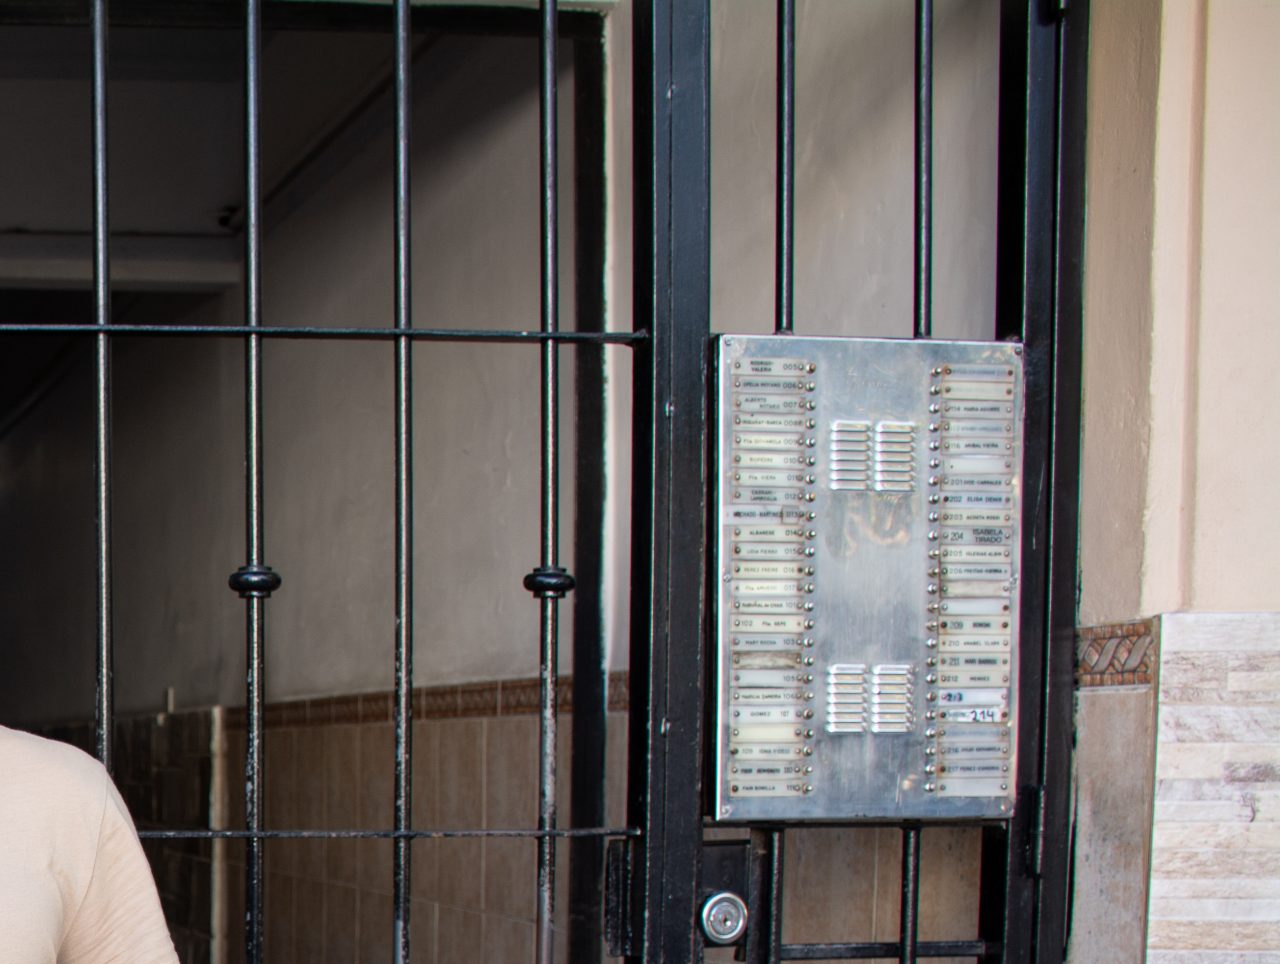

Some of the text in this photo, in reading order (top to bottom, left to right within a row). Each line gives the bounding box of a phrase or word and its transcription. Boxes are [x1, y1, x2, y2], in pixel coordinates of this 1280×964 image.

[950, 528, 1004, 542] 204 ISABELA
[974, 536, 1003, 544] TIRADO
[970, 710, 995, 722] 214
